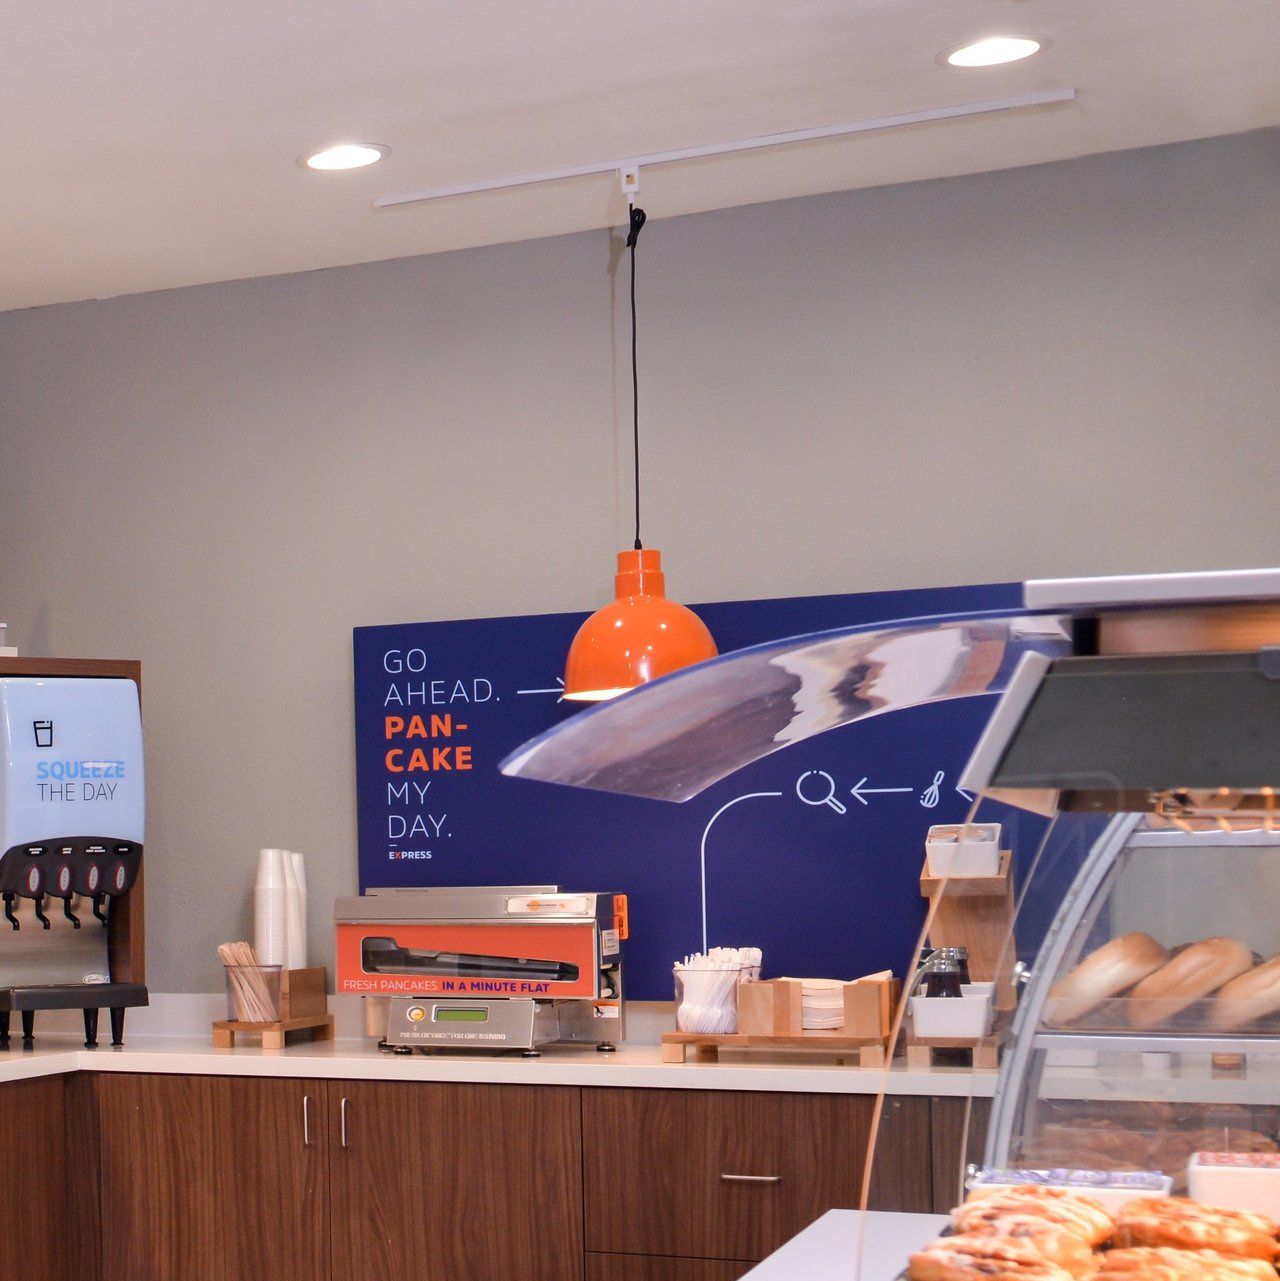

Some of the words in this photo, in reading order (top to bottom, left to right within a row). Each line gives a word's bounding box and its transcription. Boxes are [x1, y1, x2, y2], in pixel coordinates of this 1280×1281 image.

[383, 648, 427, 674] GO
[384, 678, 501, 707] AHEAD.
[384, 713, 468, 740] PAN-
[36, 760, 126, 781] SQUEEZE
[385, 746, 473, 773] CAKE
[36, 783, 75, 802] THE
[83, 783, 118, 802] DAY
[387, 780, 431, 805] MY
[388, 814, 452, 839] DAY.
[388, 850, 432, 860] EXPRESS
[343, 978, 378, 990] FRESH
[381, 979, 438, 992] PANCAKES
[442, 981, 455, 991] IN
[458, 981, 467, 991] A
[470, 981, 517, 993] MINUTE
[521, 981, 550, 993] FLAT
